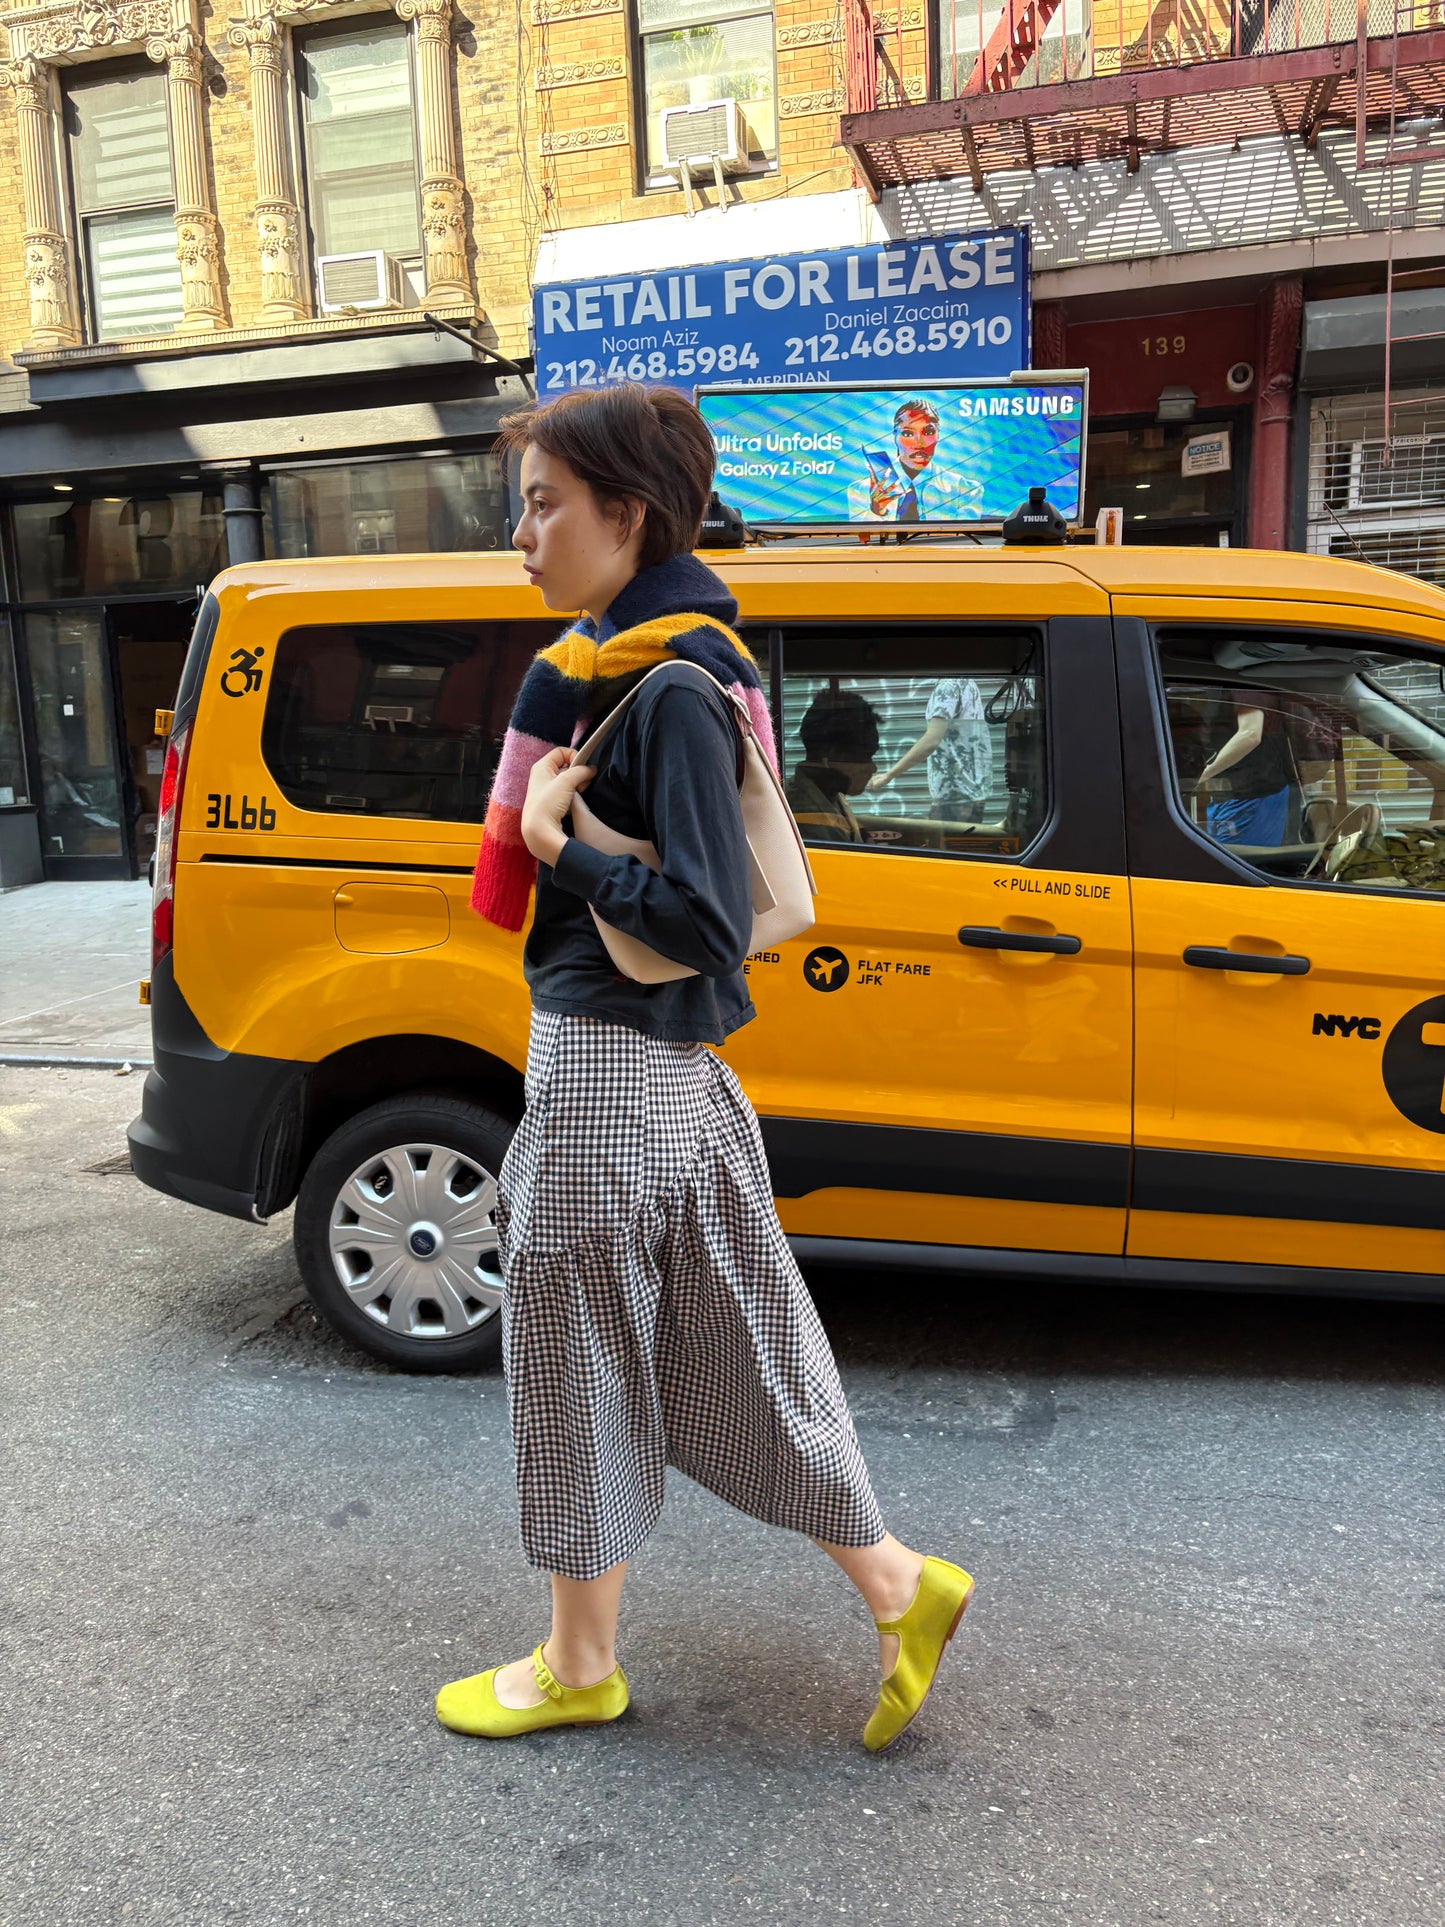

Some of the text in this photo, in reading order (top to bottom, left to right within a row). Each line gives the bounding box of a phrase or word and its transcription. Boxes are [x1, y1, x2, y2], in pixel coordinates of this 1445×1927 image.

[541, 236, 1015, 335] RETAIL FOR LEASE
[825, 300, 970, 331] Daniel Zacaim
[602, 327, 700, 354] Noam Aziz
[784, 315, 1013, 365] 212.468.5910
[1141, 336, 1186, 355] 139
[545, 342, 760, 389] 212.468.5984
[958, 395, 1074, 417] SAMSUNG
[713, 432, 843, 452] Ultra Unfolds
[1190, 443, 1221, 454] NOTICE
[720, 460, 836, 479] Galaxy Z Fold7
[702, 520, 726, 528] THULE
[1023, 515, 1049, 523] THULE
[1010, 878, 1111, 899] PULL AND SLIDE
[857, 960, 932, 976] FLAT FARE
[856, 974, 883, 986] JFK
[1312, 1013, 1382, 1040] NYC
